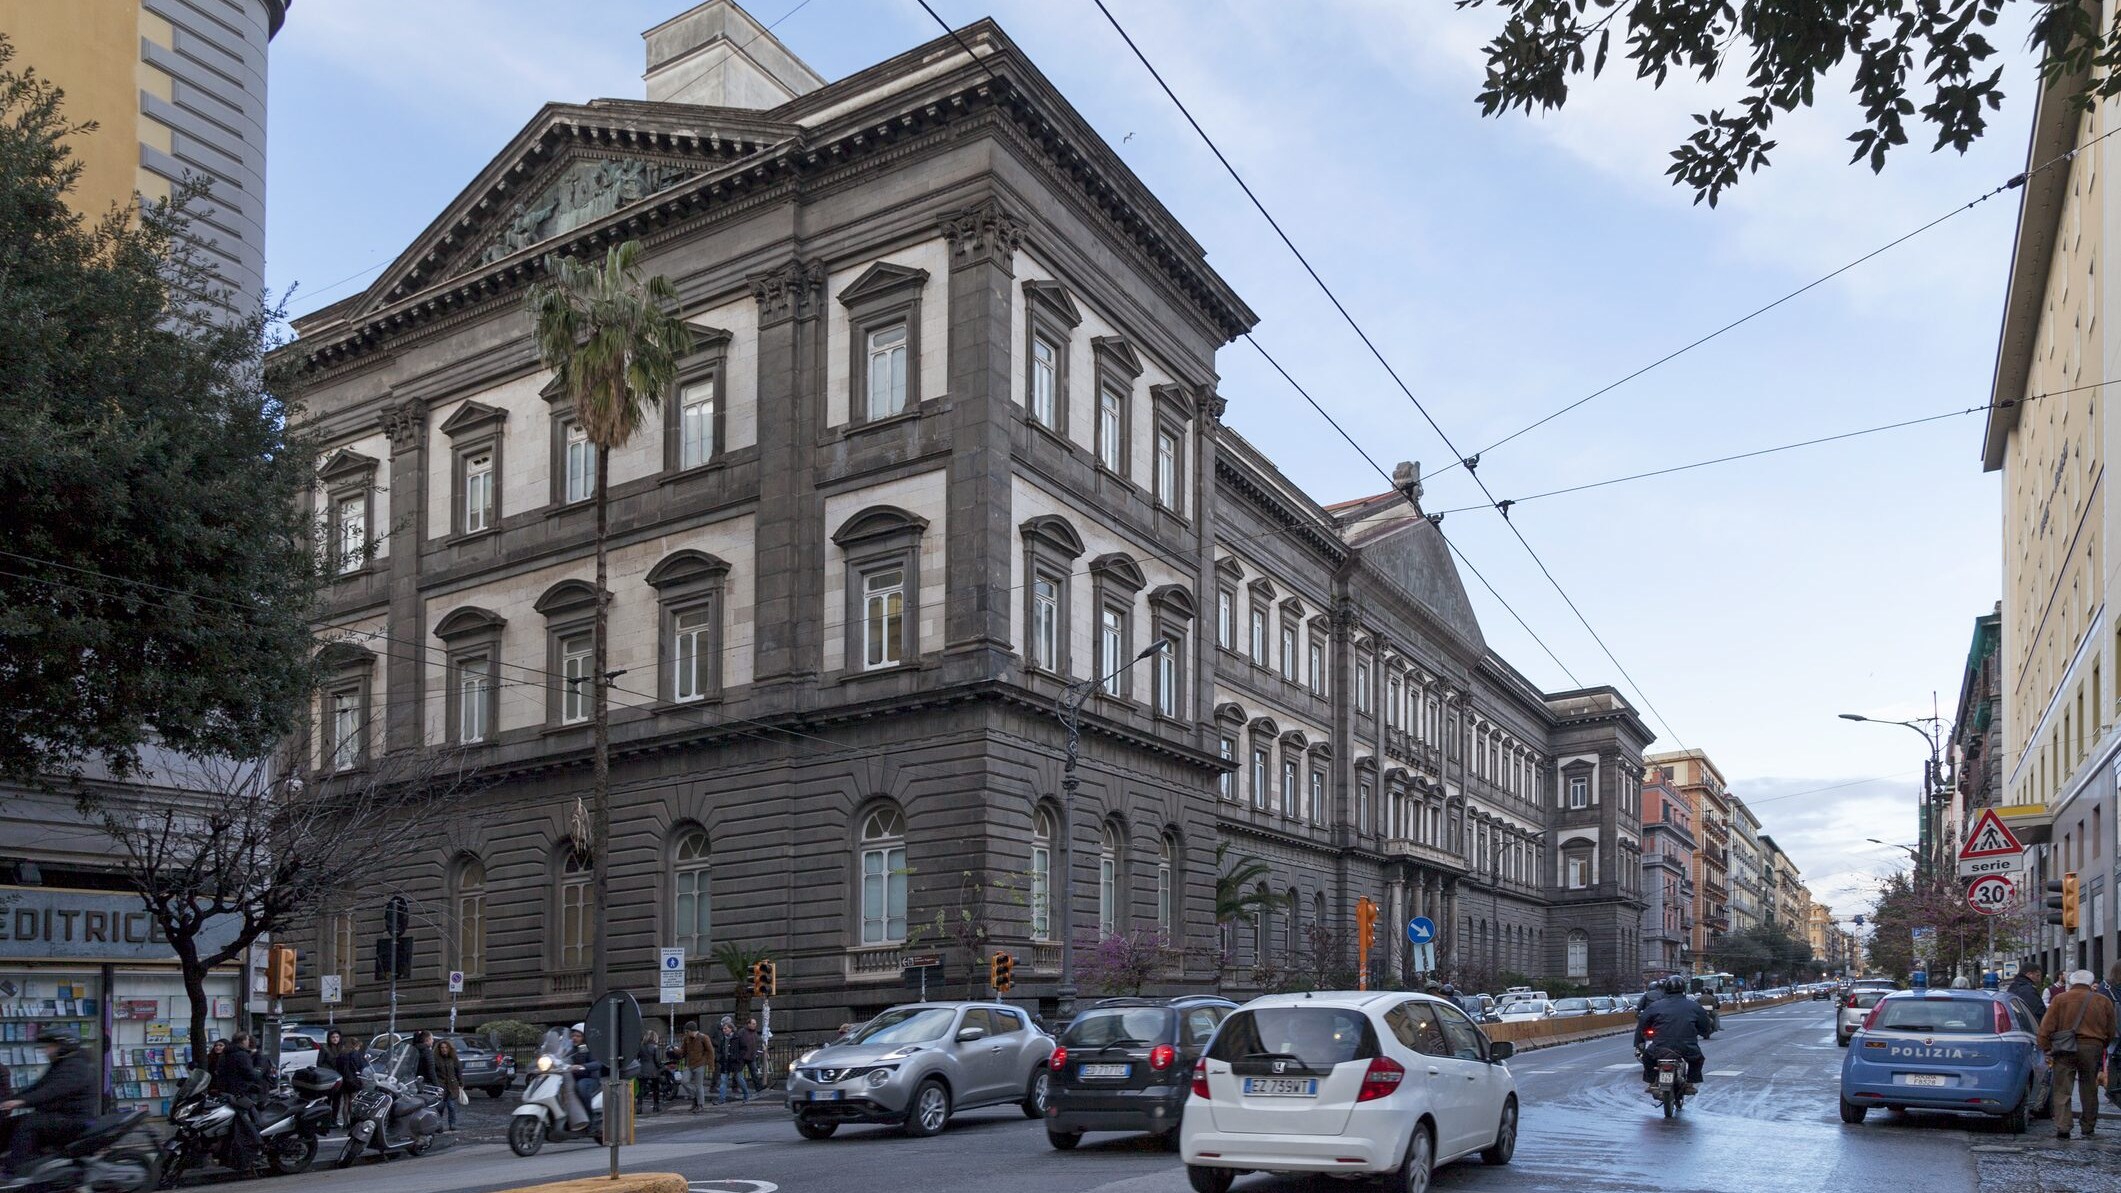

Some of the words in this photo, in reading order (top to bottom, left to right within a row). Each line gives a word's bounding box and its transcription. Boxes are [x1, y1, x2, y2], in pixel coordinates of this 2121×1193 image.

[1971, 860, 2010, 872] serie
[1978, 884, 2005, 904] 30
[1892, 1047, 1962, 1058] POLIZIA
[1252, 1080, 1267, 1092] EZ
